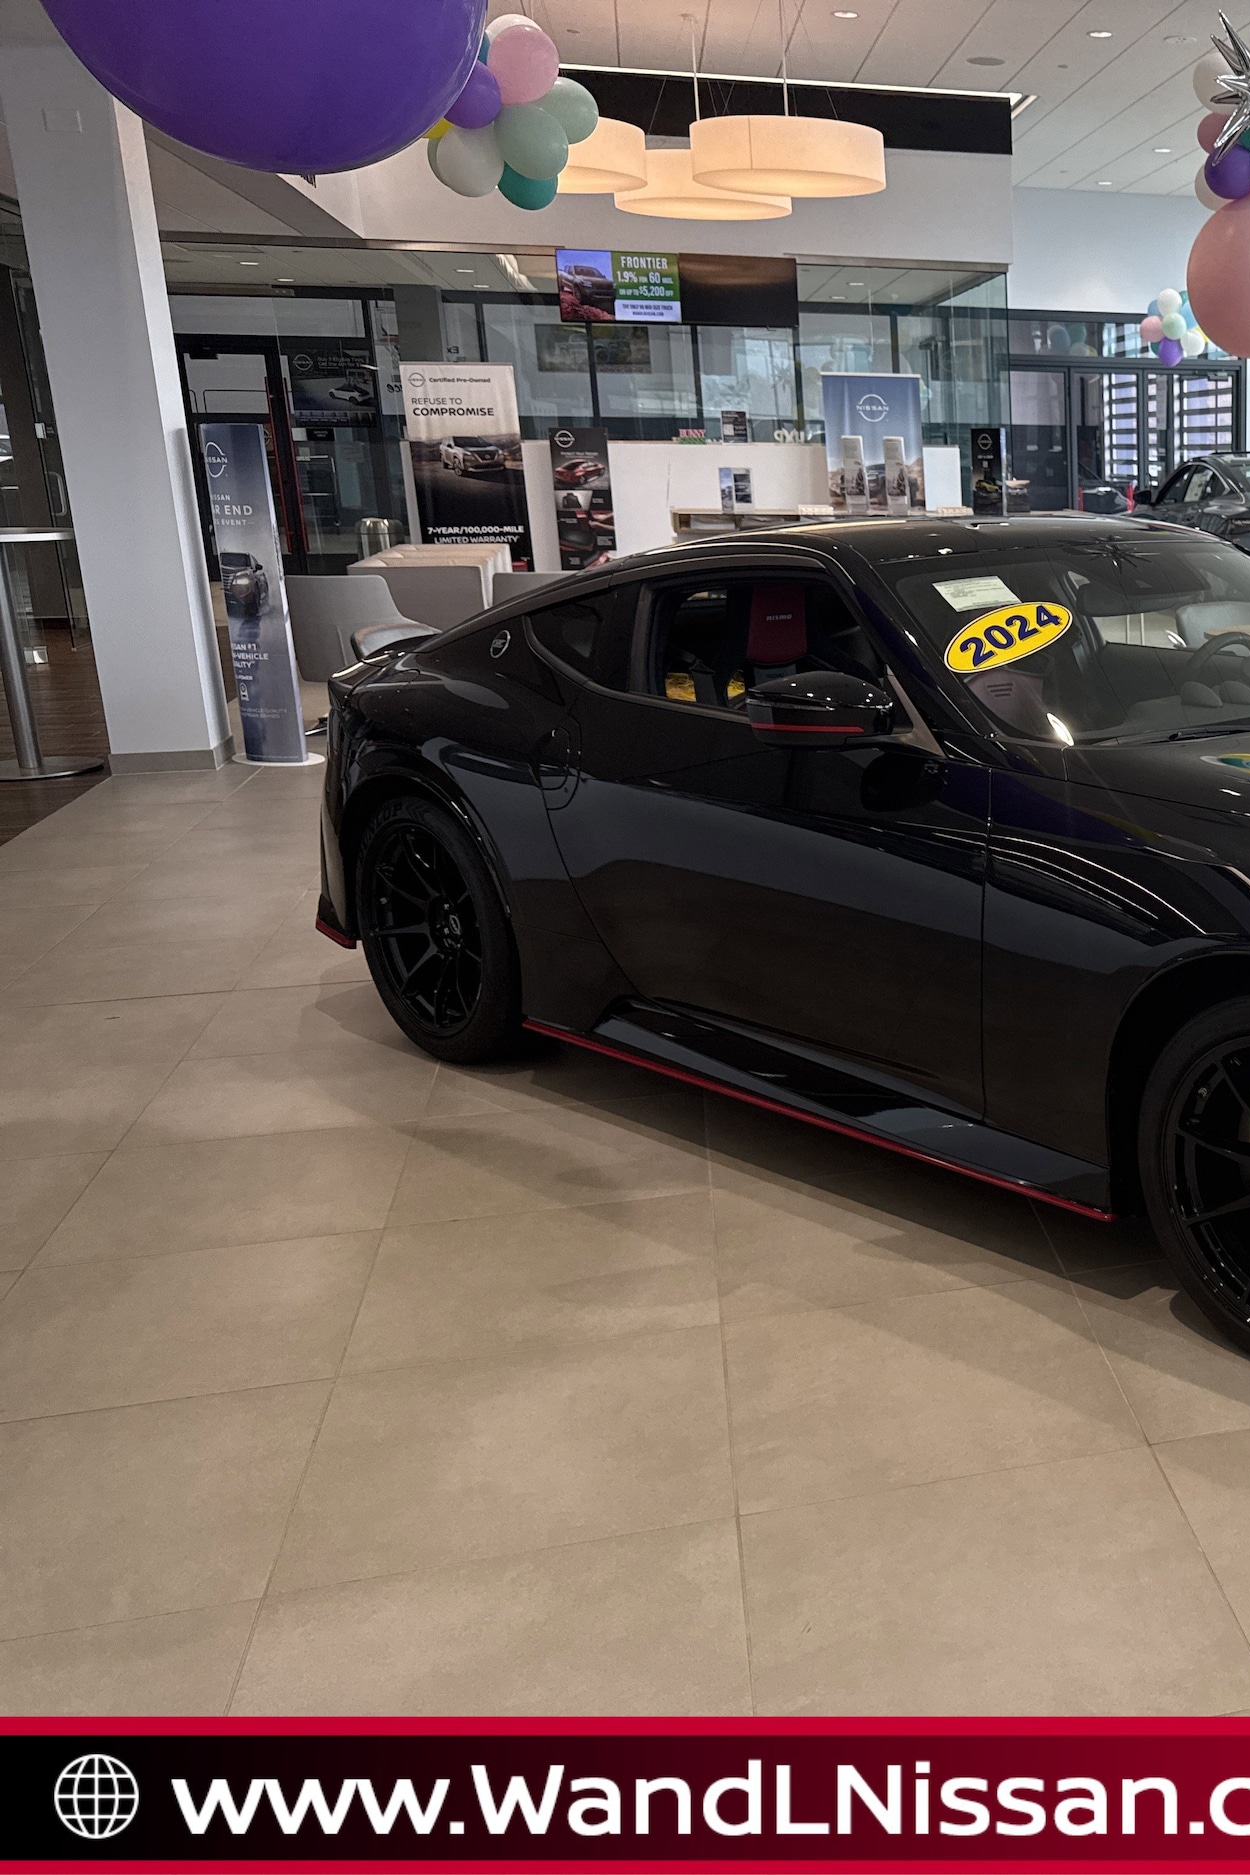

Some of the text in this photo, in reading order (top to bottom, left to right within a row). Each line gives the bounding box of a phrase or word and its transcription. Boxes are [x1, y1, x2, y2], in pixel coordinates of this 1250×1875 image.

[621, 256, 668, 269] FRONTIER
[616, 271, 638, 283] 1.9%
[648, 272, 661, 284] 60
[639, 286, 665, 297] $5,200
[411, 397, 462, 405] REFUSE TO
[412, 407, 495, 417] COMPROMISE
[856, 404, 889, 412] NISSAN
[224, 504, 253, 516] END
[221, 519, 247, 527] EVENT
[427, 525, 525, 535] 7-YEAR/100,000-MILE
[434, 535, 519, 545] LIMITED WARRANTY
[959, 604, 1063, 668] 2024
